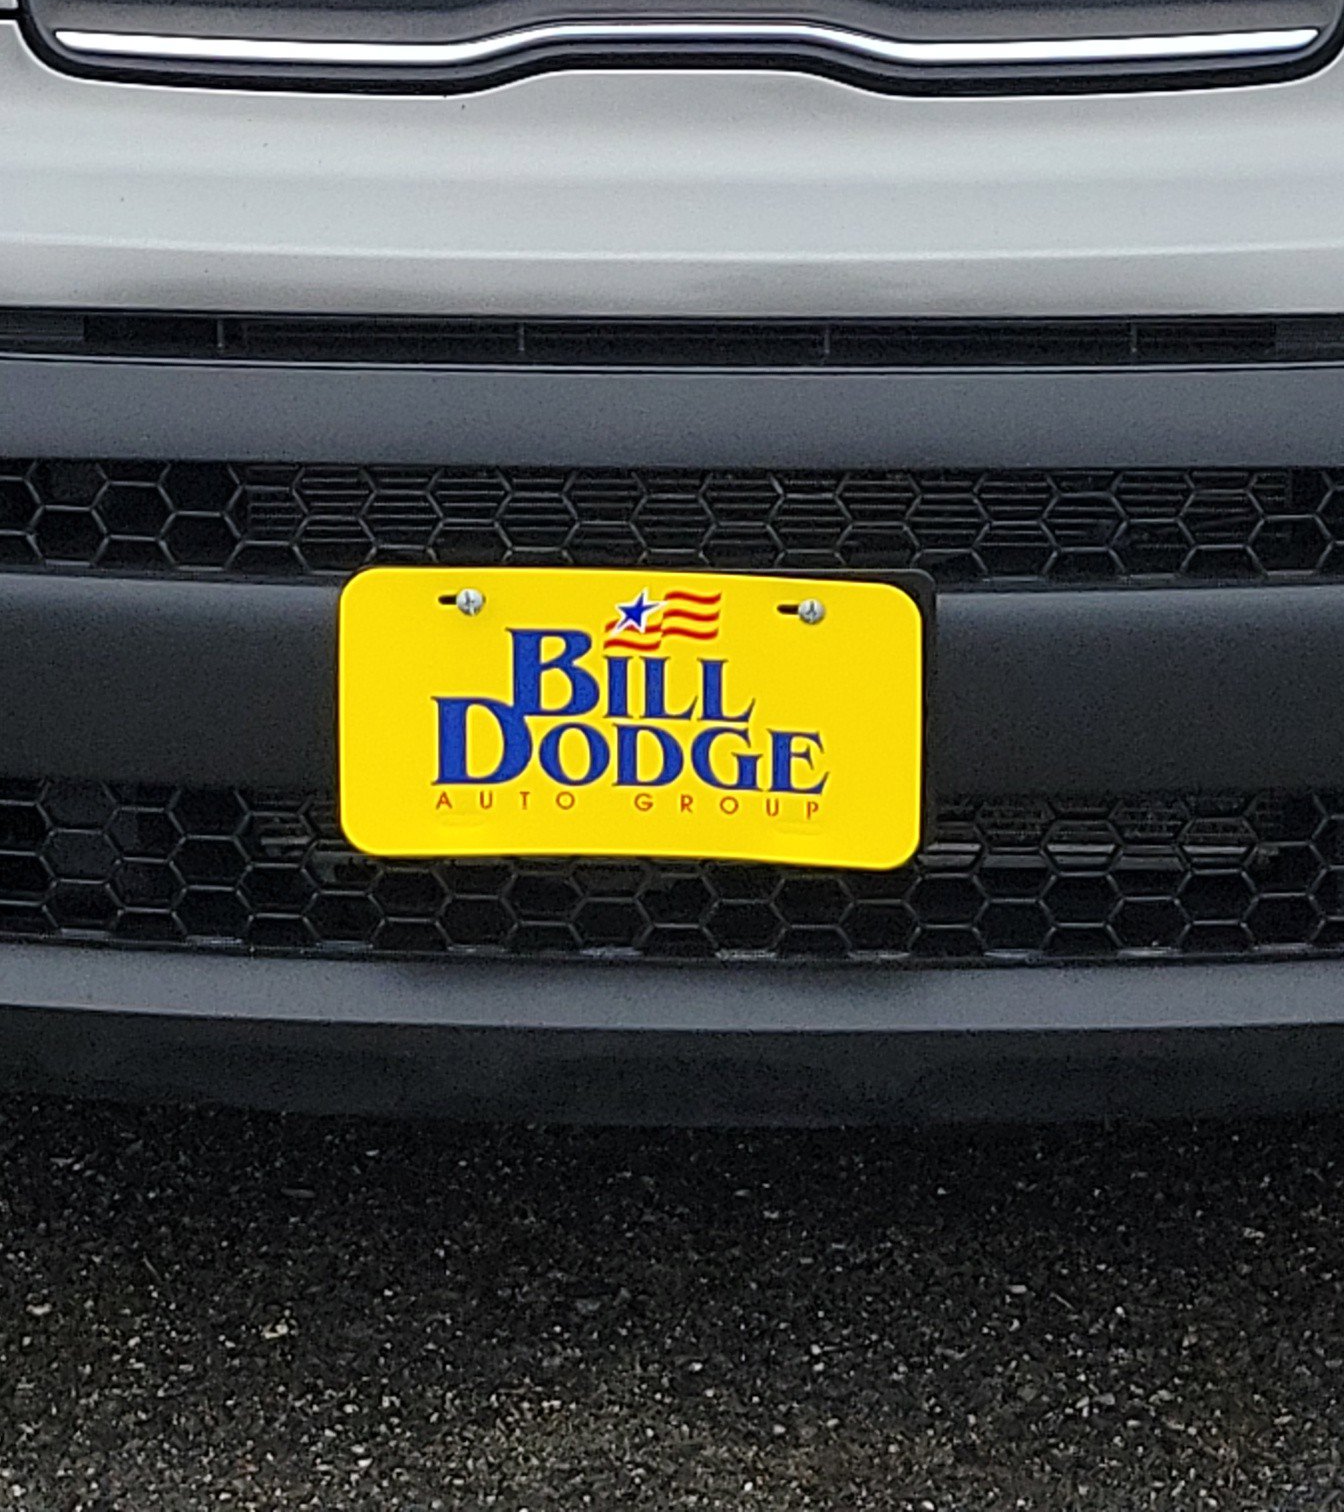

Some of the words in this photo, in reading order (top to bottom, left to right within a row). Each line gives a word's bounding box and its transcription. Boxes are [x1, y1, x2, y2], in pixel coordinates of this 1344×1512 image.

[506, 628, 755, 722] BILL
[431, 696, 829, 794] DODGE
[435, 791, 576, 811] AUTO
[633, 792, 821, 820] GROUP
